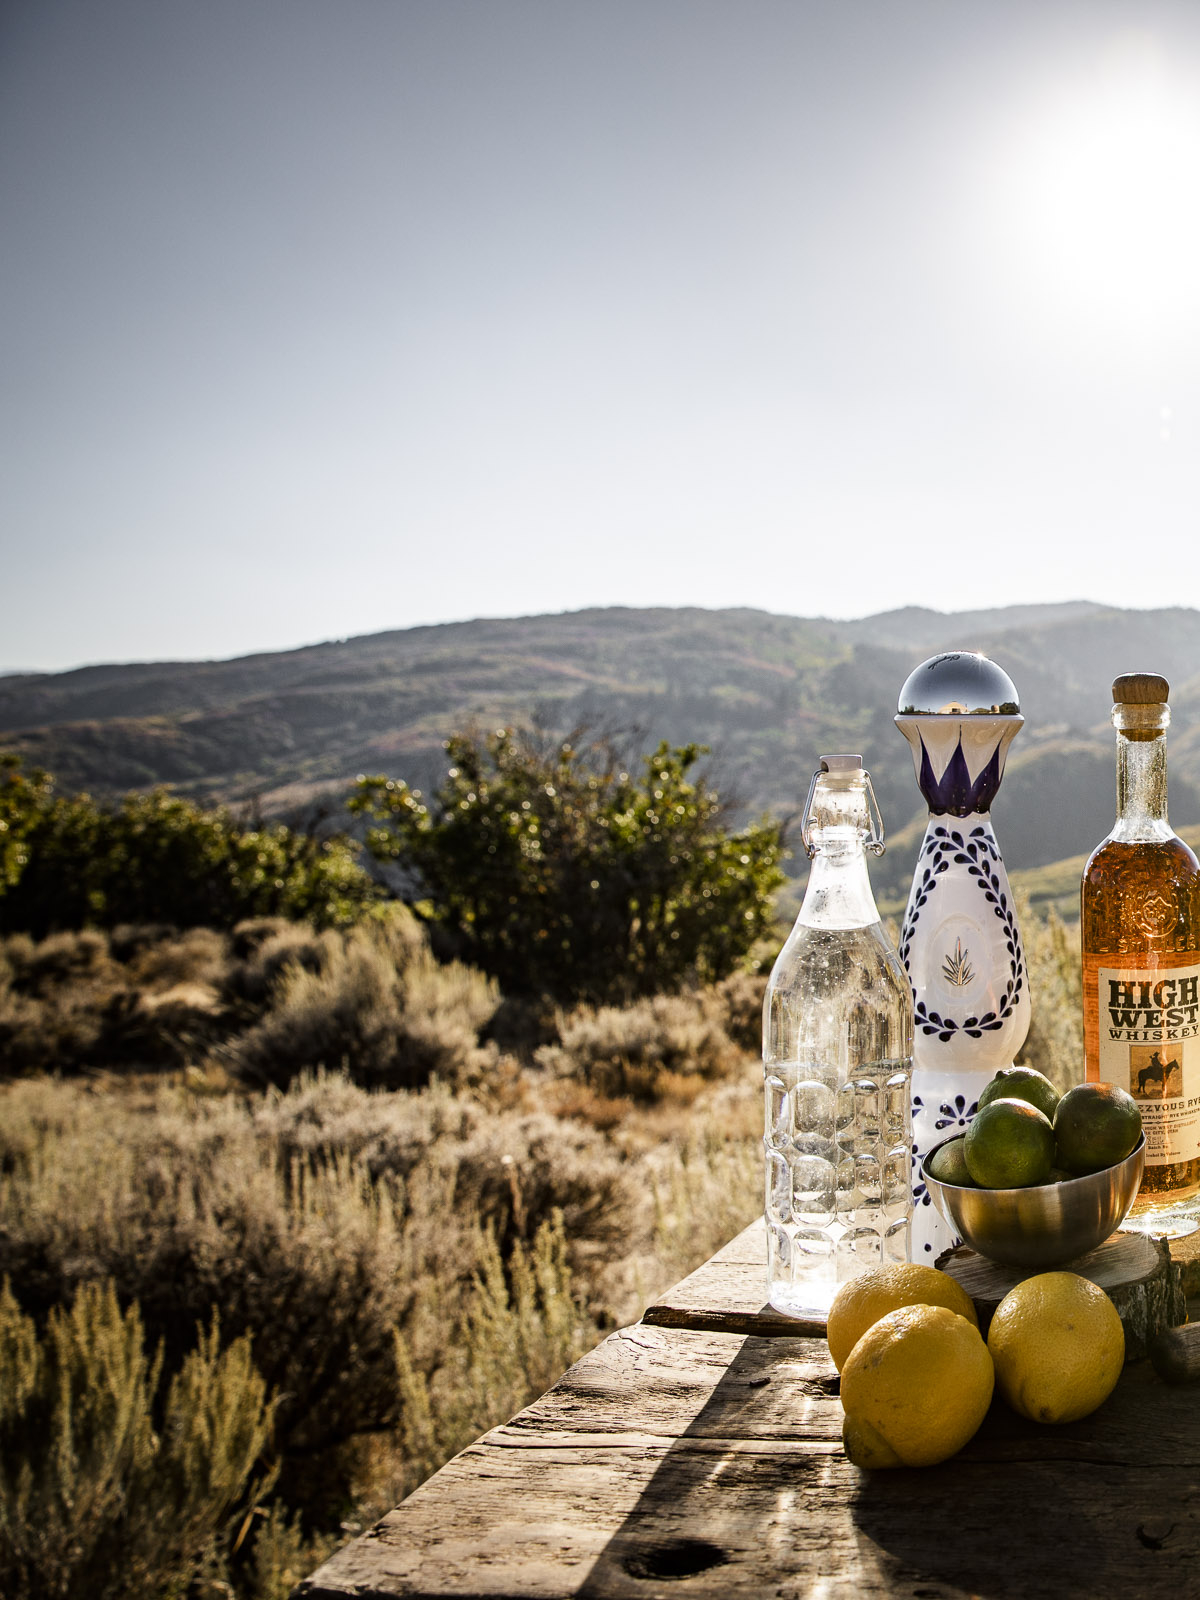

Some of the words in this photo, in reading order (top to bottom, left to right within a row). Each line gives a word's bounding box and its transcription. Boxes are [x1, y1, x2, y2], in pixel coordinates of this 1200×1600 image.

[1108, 976, 1198, 1009] HIGH
[1108, 1004, 1199, 1028] WEST
[1109, 1025, 1199, 1040] WHISKEY
[1138, 1102, 1185, 1112] EZVOUS
